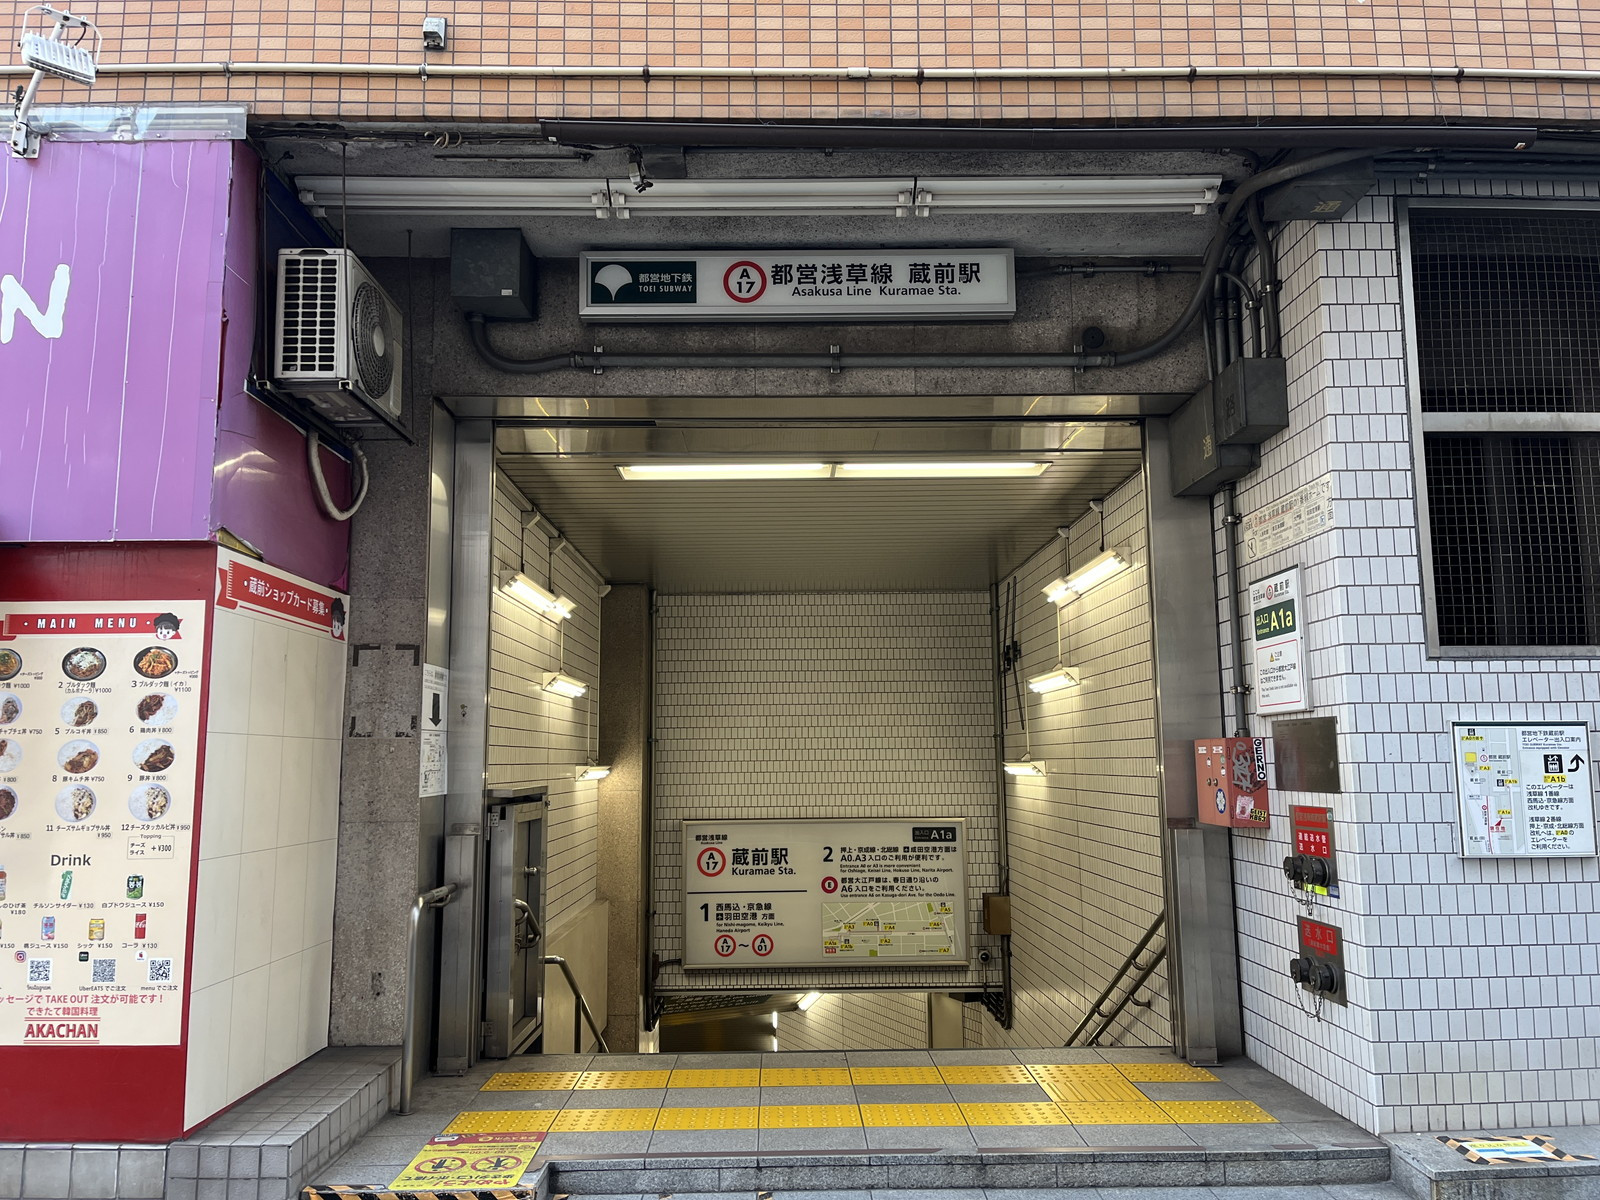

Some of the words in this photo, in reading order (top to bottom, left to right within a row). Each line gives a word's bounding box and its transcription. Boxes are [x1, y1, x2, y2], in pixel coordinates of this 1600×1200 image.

[638, 273, 693, 283] 都営地下鉄
[739, 268, 751, 280] A
[770, 263, 894, 285] 都営浅草線
[908, 262, 981, 284] 蔵前駅
[638, 285, 656, 293] TOEI
[659, 285, 693, 293] SUBWAY
[736, 281, 756, 294] 17
[791, 286, 843, 297] Asakusa
[846, 286, 872, 296] Line
[879, 285, 935, 296] Kuramae
[938, 285, 961, 295] Sta.
[248, 576, 326, 616] 蔵前ショップカード募集
[37, 618, 77, 629] MAIN
[94, 617, 137, 629] MENU
[1270, 608, 1293, 631] A1a
[1253, 738, 1267, 780] GERNO
[930, 829, 953, 840] A1a
[50, 854, 92, 866] Drink
[707, 852, 716, 861] A
[731, 847, 789, 866] 蔵前駅
[822, 846, 834, 862] 2
[705, 861, 719, 870] 17
[731, 867, 775, 876] Kuramae
[778, 866, 797, 875] Sta.
[700, 903, 709, 922] 1
[716, 902, 773, 911] 西馬込・京急線
[724, 912, 758, 921] 羽田空港
[761, 912, 775, 920] 方面
[1304, 924, 1334, 944] 送水口
[757, 944, 768, 952] 01
[45, 994, 68, 1004] TAKE
[69, 994, 89, 1004] OUT
[27, 1006, 99, 1017] できたて韓国料理
[24, 1023, 99, 1039] AKACHAN
